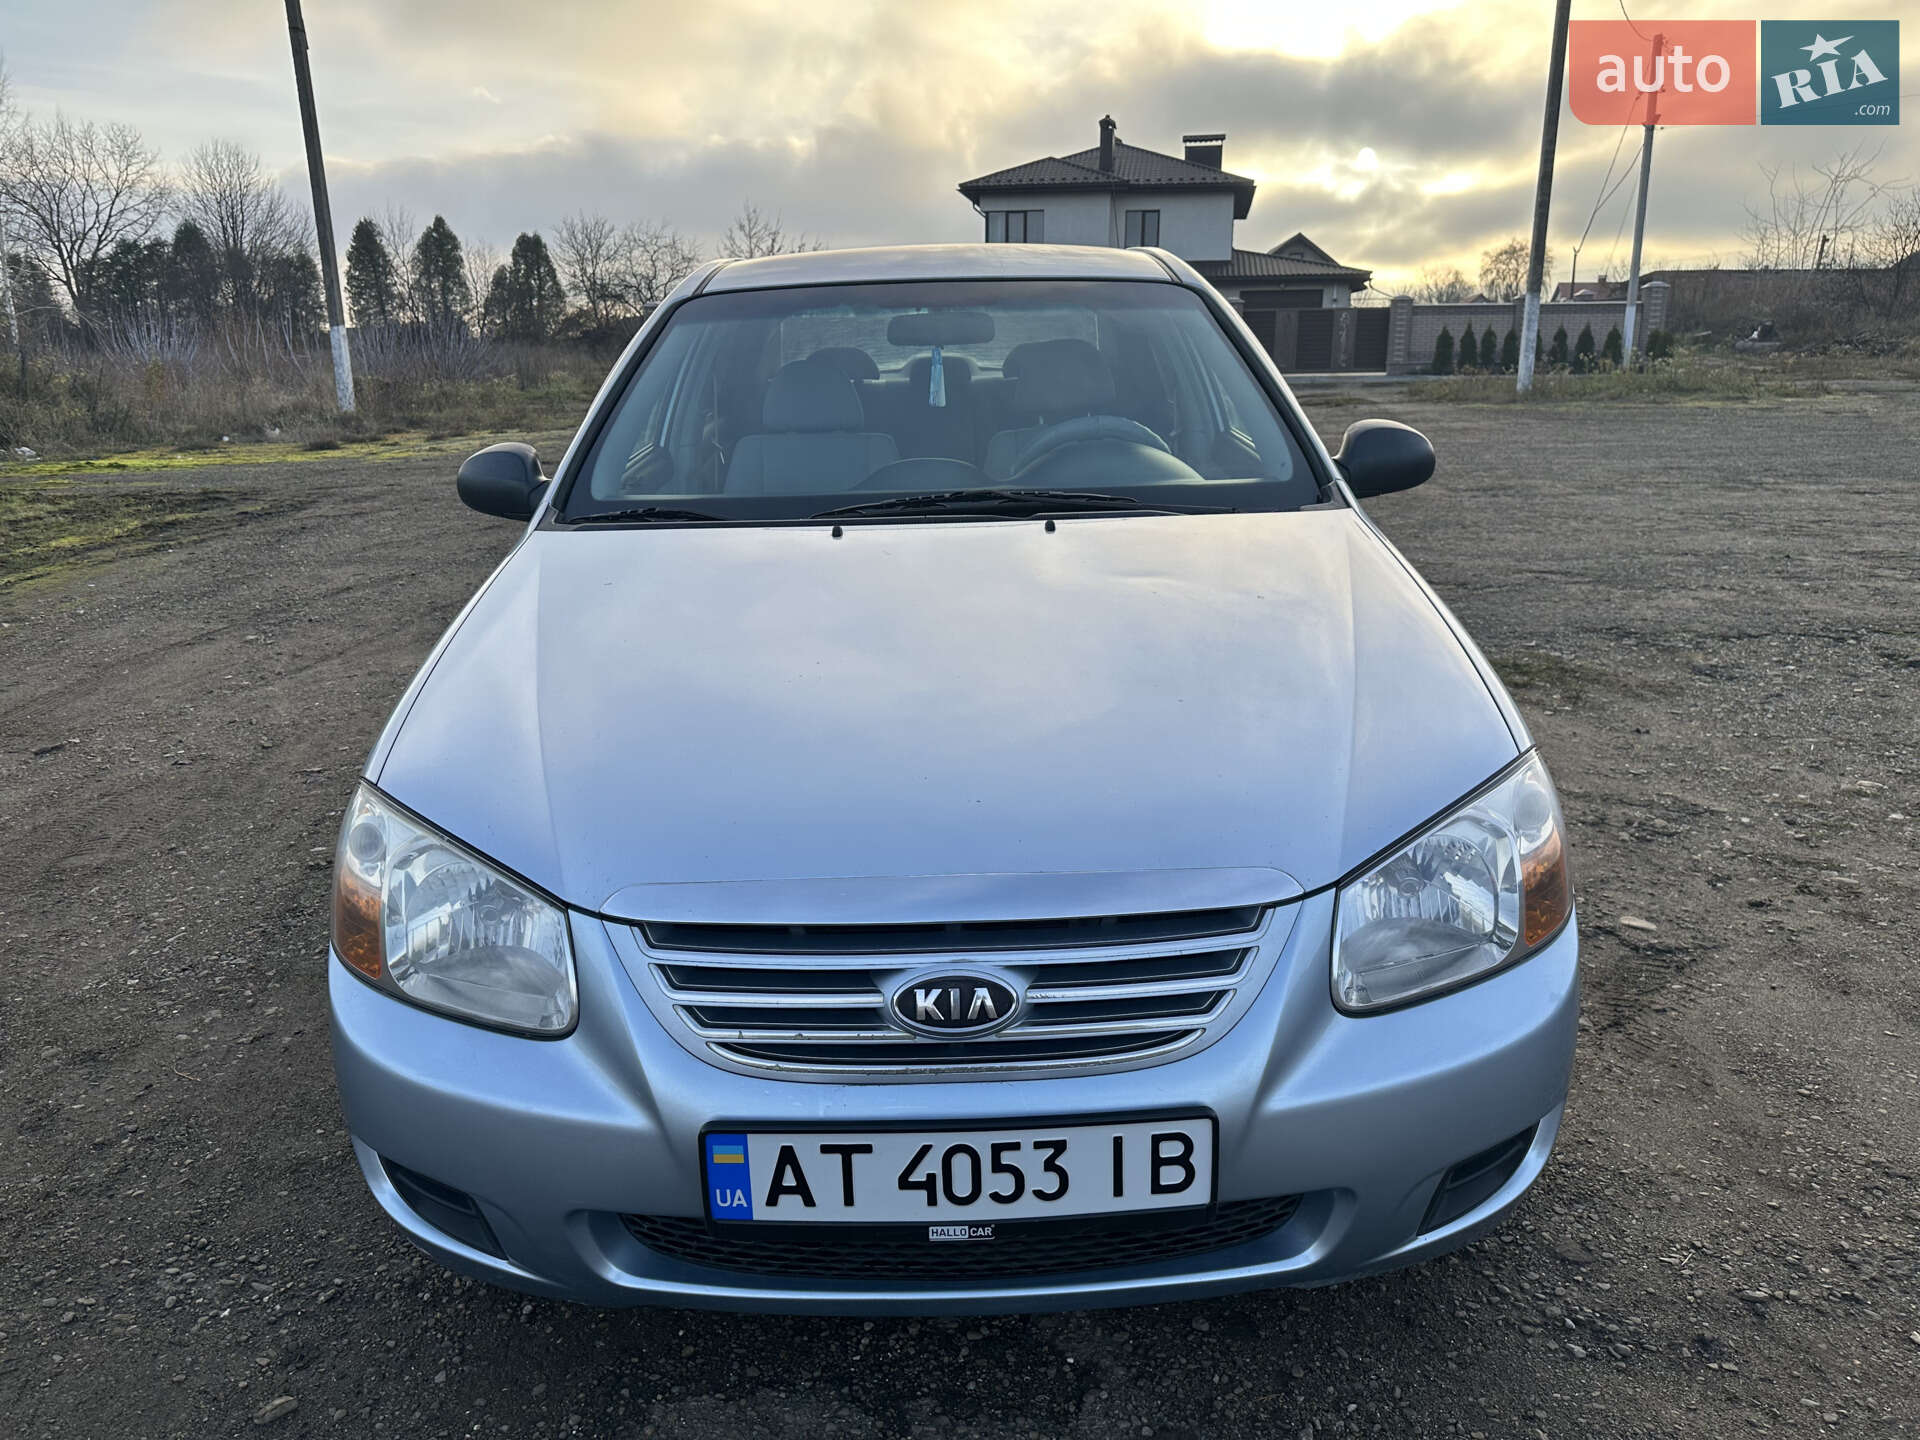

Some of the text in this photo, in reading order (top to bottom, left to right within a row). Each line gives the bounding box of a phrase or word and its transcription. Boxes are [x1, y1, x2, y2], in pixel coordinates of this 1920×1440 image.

[914, 987, 999, 1021] KIA
[765, 1131, 1197, 1207] AT 4053 IB
[716, 1188, 748, 1207] UA
[931, 1227, 992, 1237] HALLO CAR
